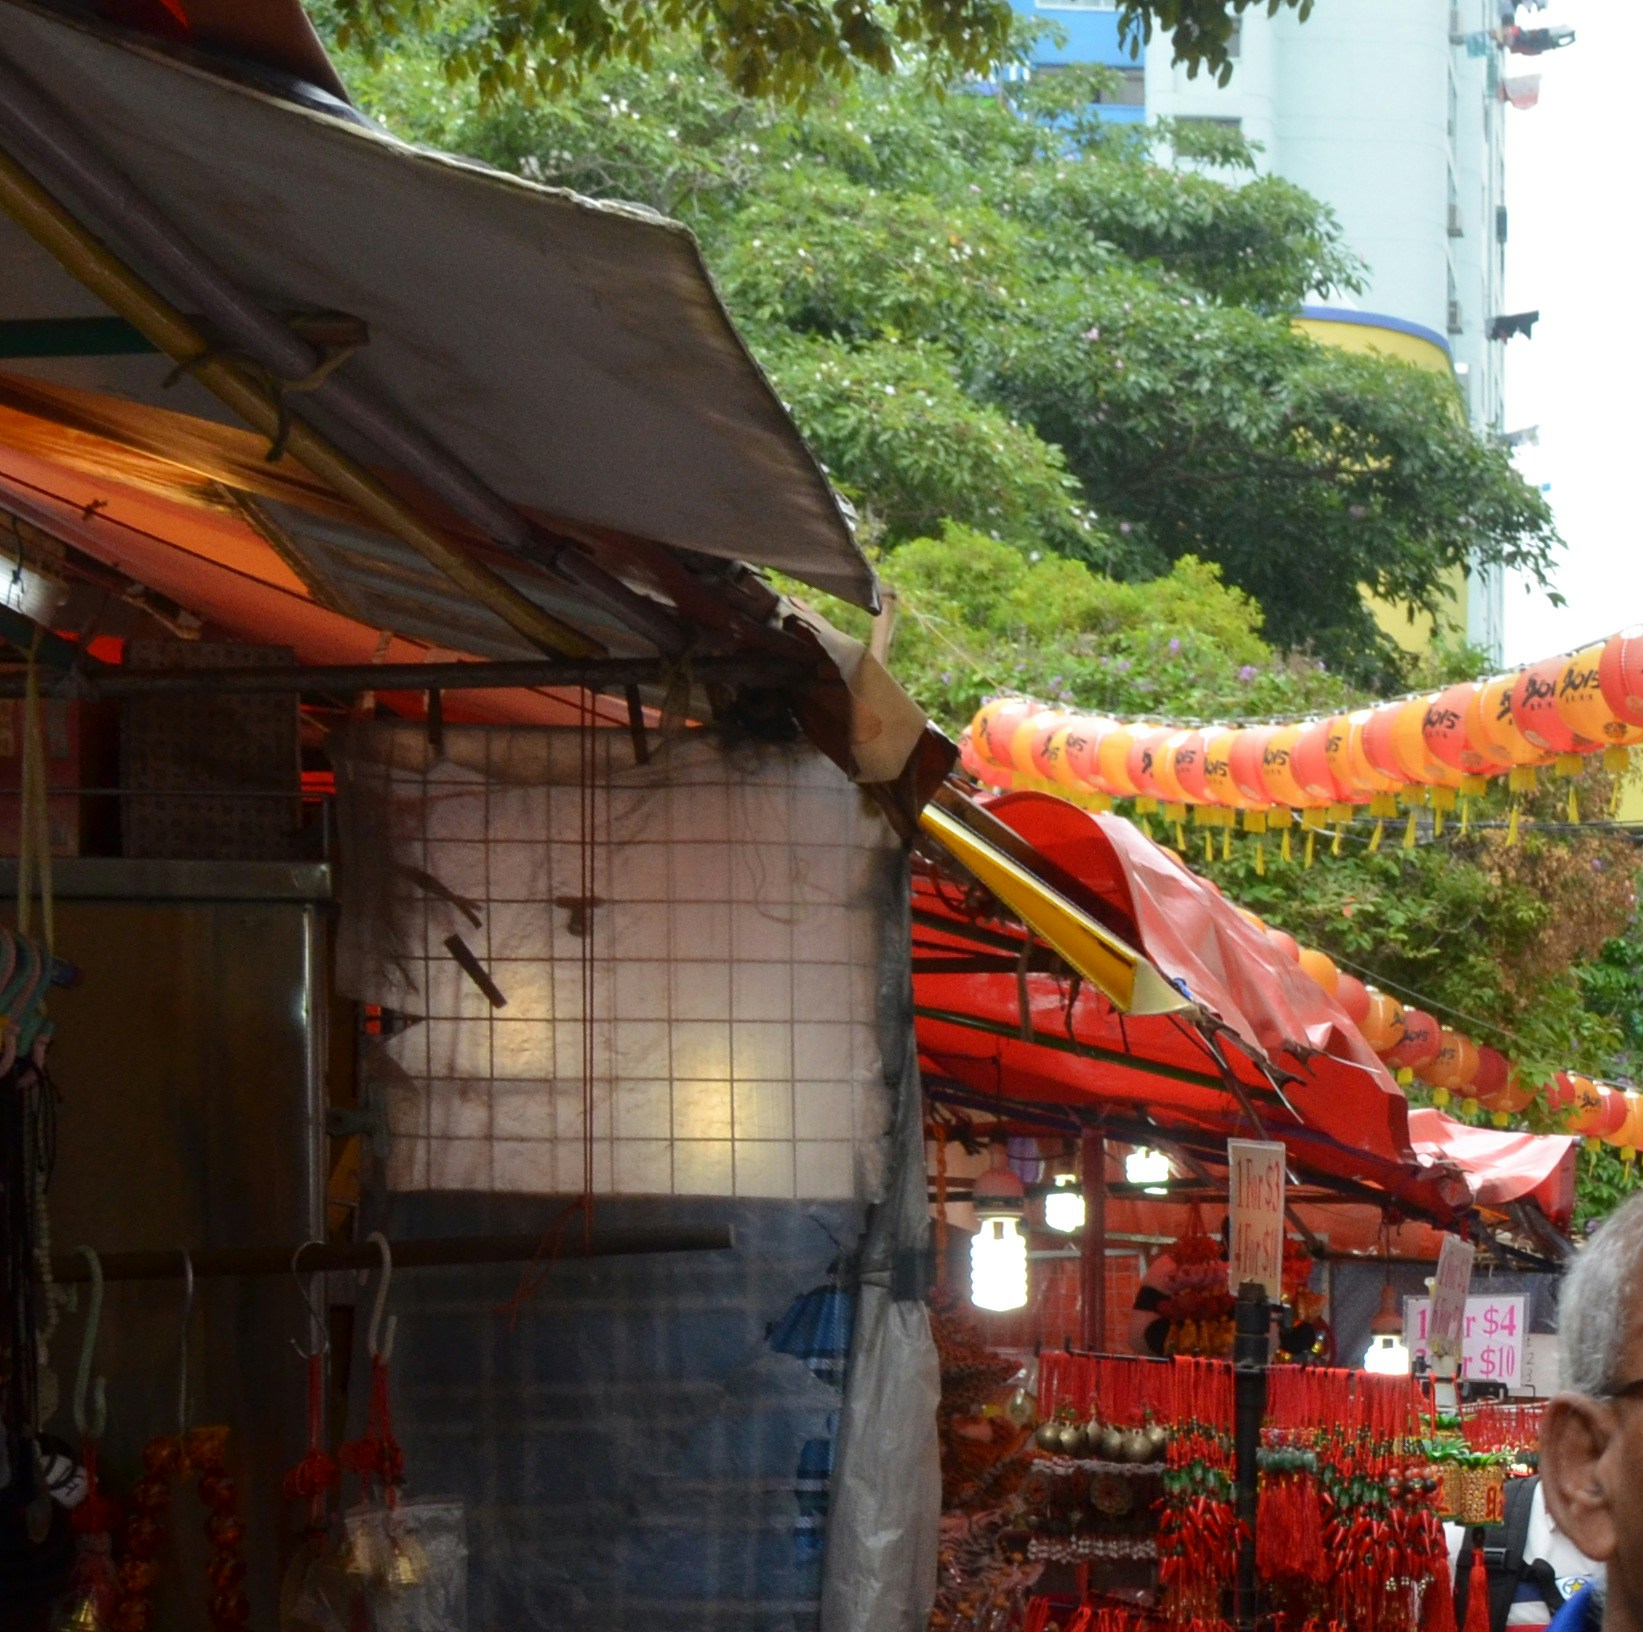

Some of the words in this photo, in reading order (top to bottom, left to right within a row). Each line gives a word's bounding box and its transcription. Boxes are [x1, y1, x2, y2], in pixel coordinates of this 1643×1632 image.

[1522, 673, 1557, 708] 201
[1482, 1304, 1517, 1338] $4
[1480, 1344, 1516, 1379] $10
